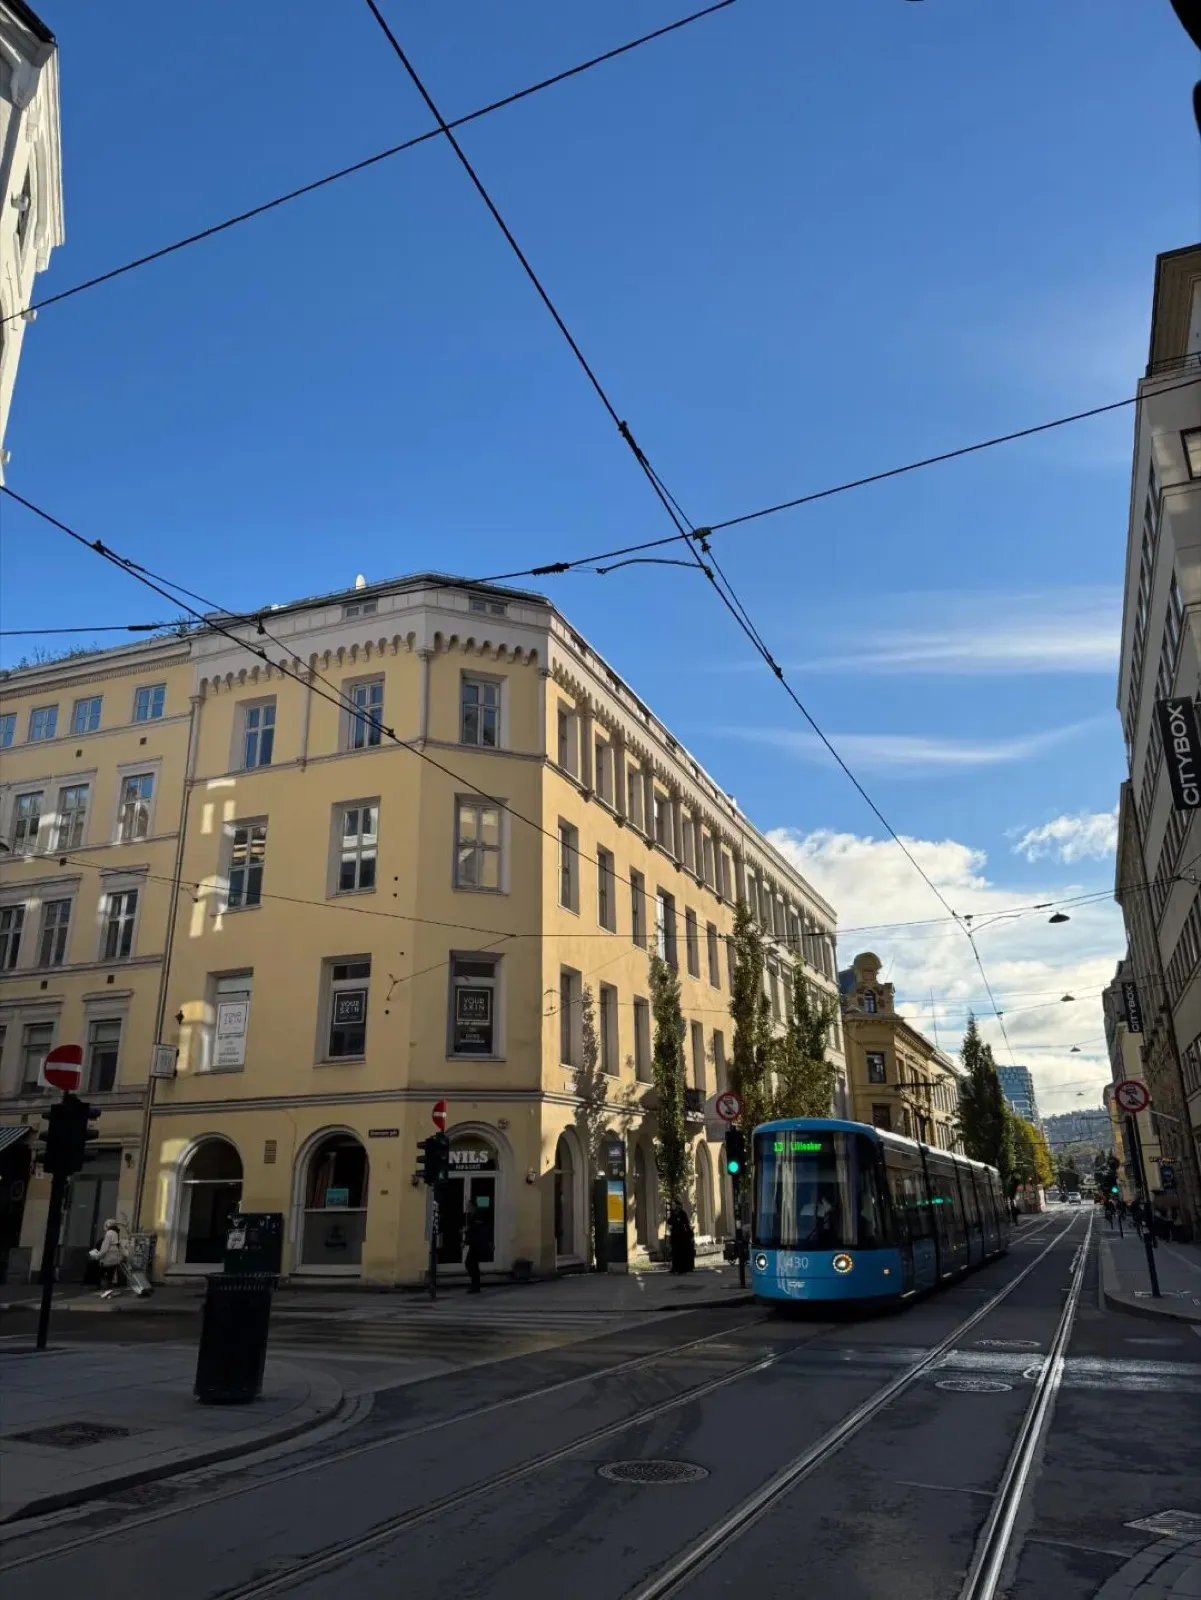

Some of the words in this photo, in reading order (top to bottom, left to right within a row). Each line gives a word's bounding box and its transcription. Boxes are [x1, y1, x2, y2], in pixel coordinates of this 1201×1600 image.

[1167, 704, 1200, 805] CITYBOX
[463, 996, 485, 1004] YOUR
[463, 1003, 485, 1011] SKIN
[1124, 985, 1140, 1032] CITYBOX
[449, 1150, 489, 1164] NILS
[786, 1256, 809, 1269] 430
